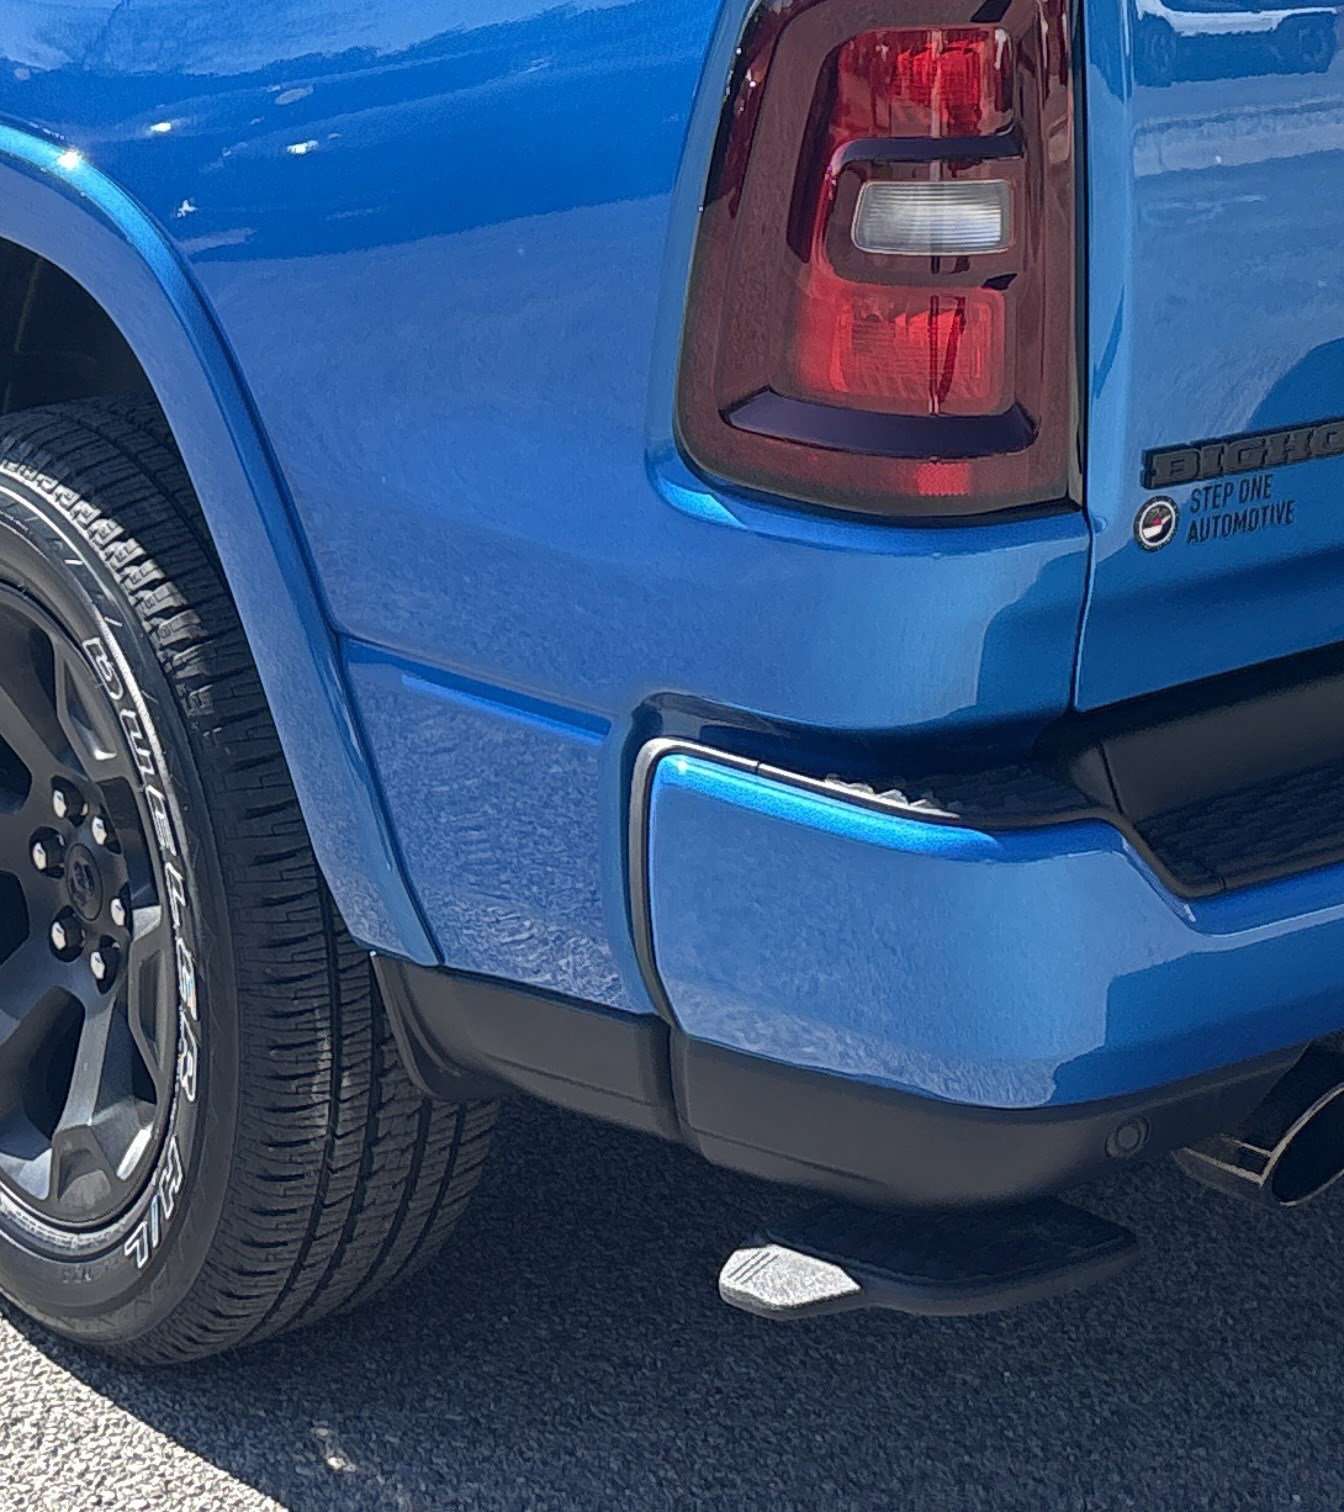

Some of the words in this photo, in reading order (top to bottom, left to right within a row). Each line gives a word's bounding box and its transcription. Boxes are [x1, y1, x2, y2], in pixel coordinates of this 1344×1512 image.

[1190, 481, 1234, 513] STEP
[1238, 474, 1274, 504] ONE
[1186, 499, 1297, 546] AUTOMOTIVE
[83, 637, 199, 1102] DUELER
